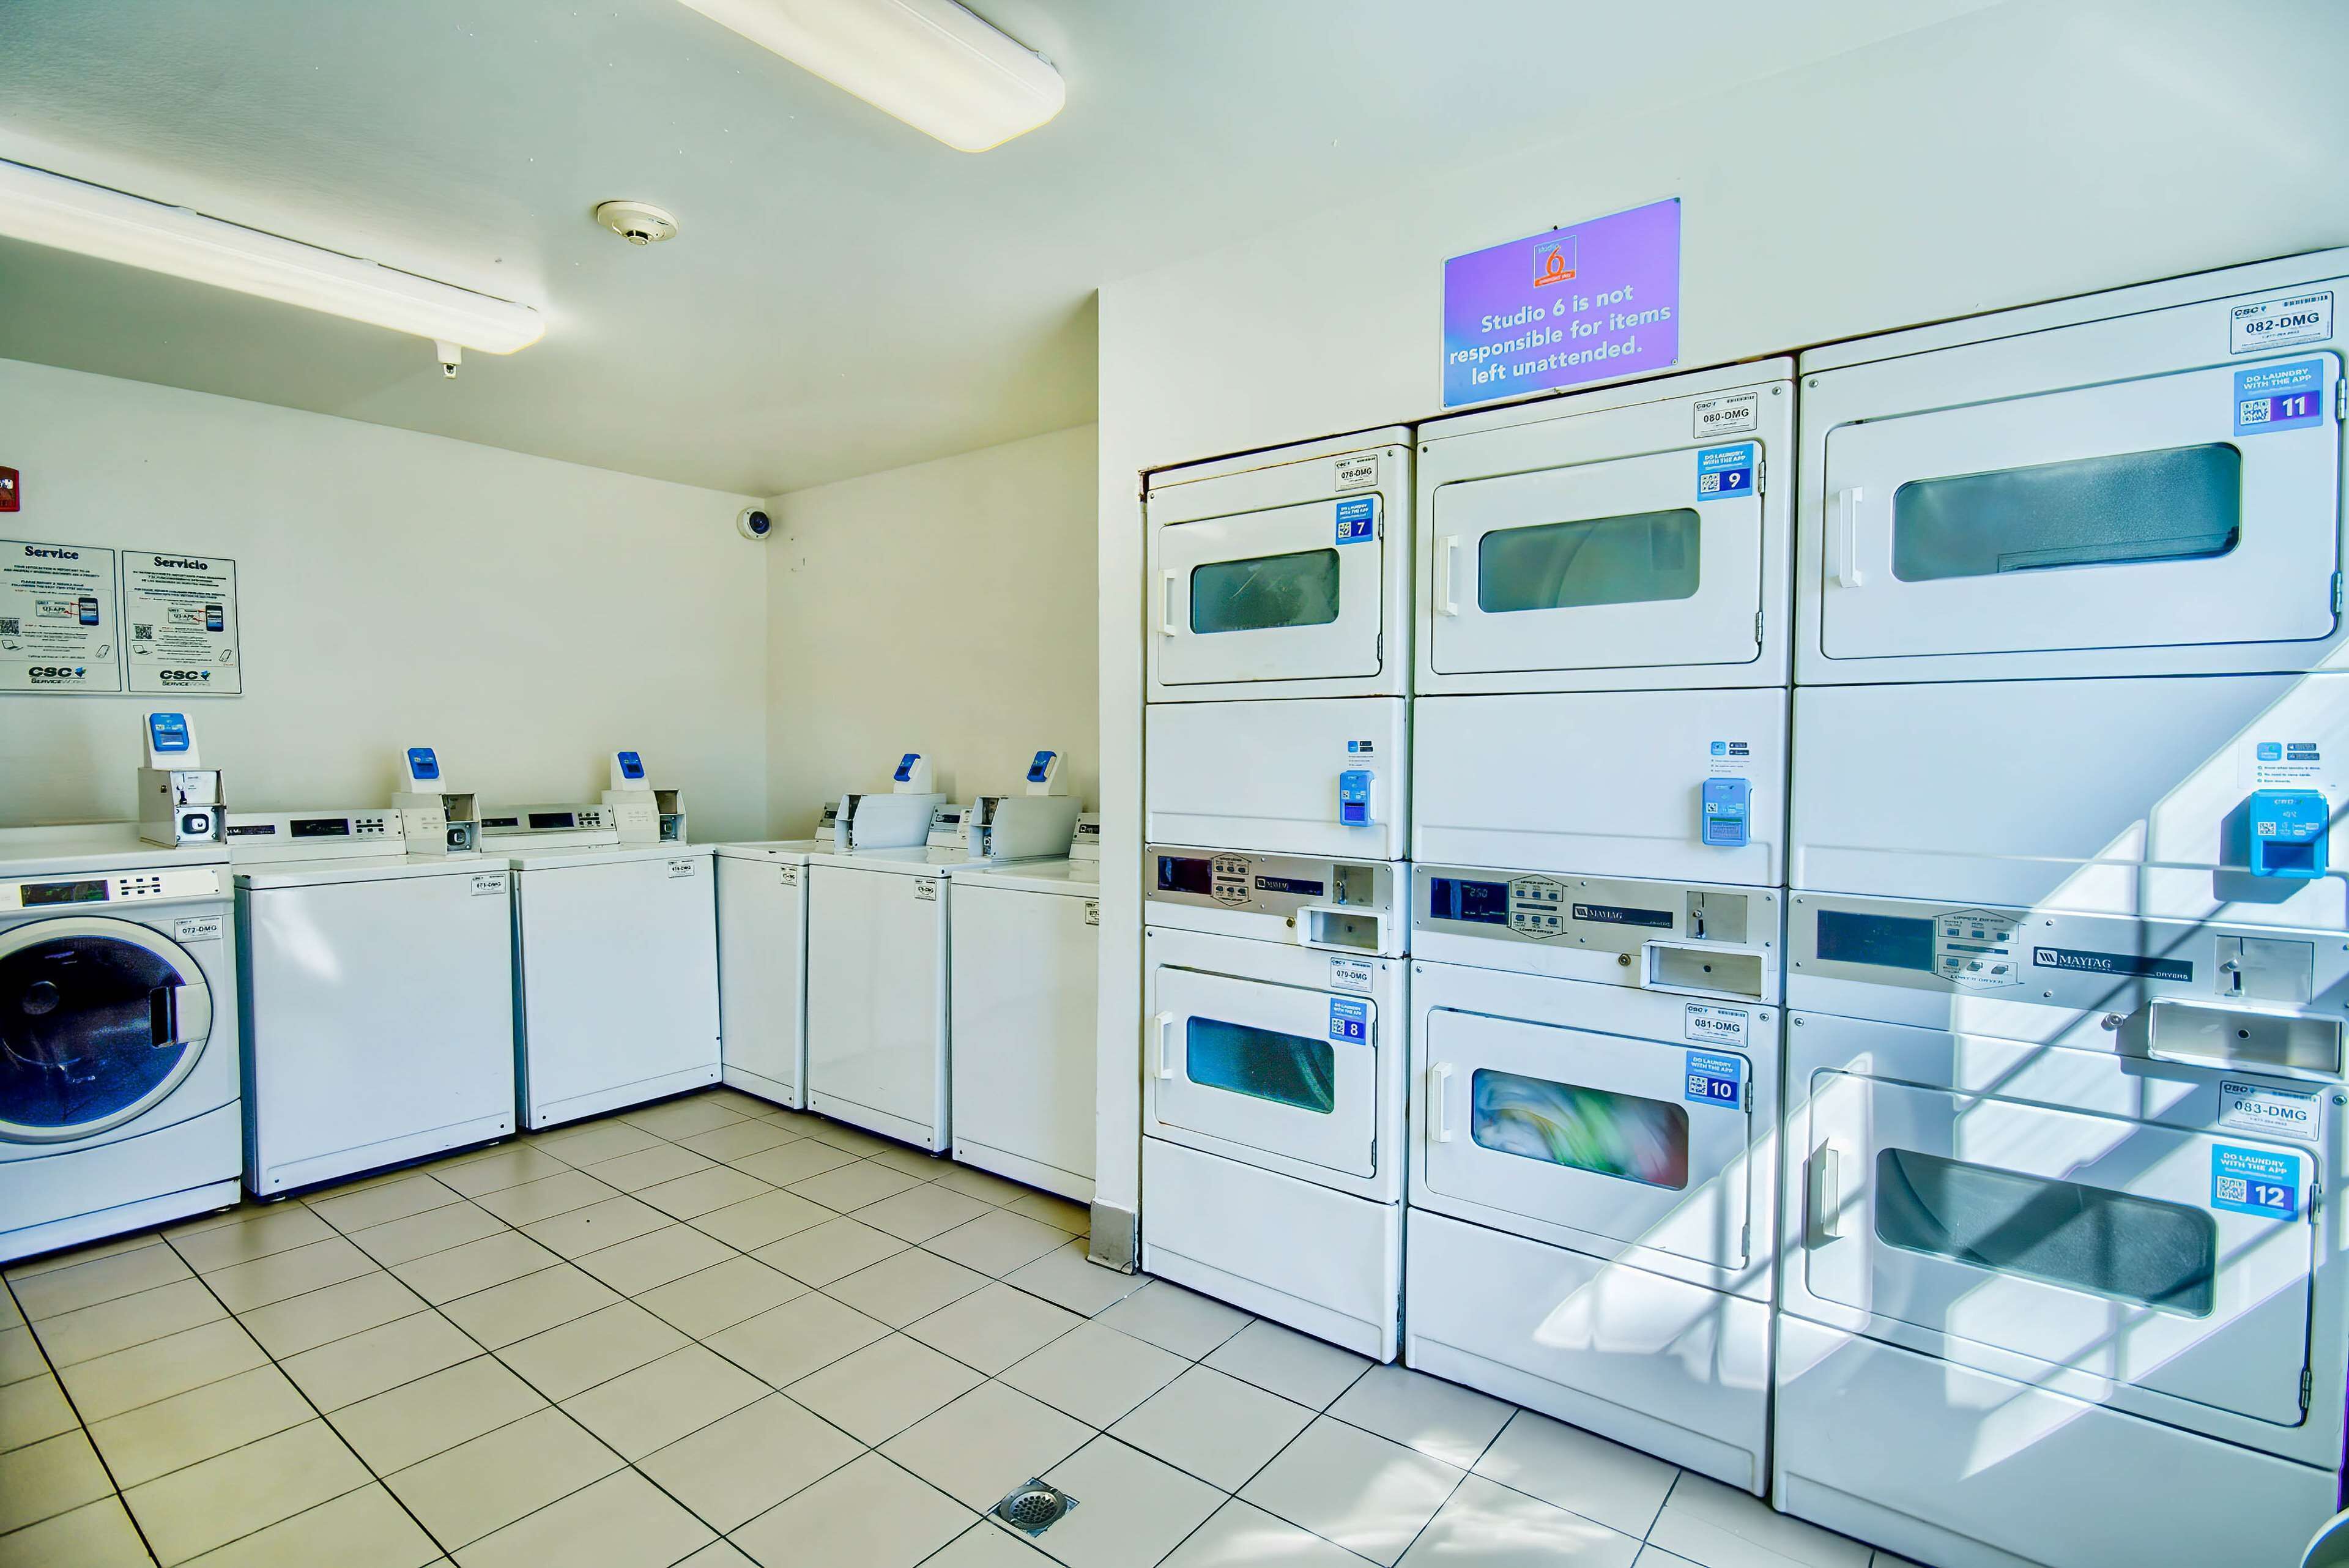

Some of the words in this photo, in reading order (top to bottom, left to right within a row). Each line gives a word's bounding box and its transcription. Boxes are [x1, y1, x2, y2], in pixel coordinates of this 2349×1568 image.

[1546, 245, 1565, 275] 6
[1482, 306, 1545, 333] Studio
[1553, 299, 1565, 317] 6
[1573, 295, 1589, 313] is
[1596, 284, 1634, 308] not
[2246, 312, 2320, 333] 082-DMG
[1450, 327, 1563, 365] responsible
[1570, 320, 1602, 339] for
[1609, 306, 1671, 332] items
[1472, 364, 1507, 385] left
[1513, 336, 1642, 377] unattended.
[2243, 381, 2269, 390] WITH
[2271, 377, 2290, 386] THE
[2291, 374, 2312, 384] APP
[2262, 368, 2309, 381] LAUNDRY
[2282, 396, 2306, 417] 11
[1704, 408, 1750, 423] 080-DMG
[1341, 467, 1373, 478] 078-DMG
[1729, 472, 1741, 488] 9
[1357, 521, 1365, 534] 7
[25, 546, 79, 560] Service
[154, 556, 208, 570] Servicio
[29, 666, 72, 677] CSC
[160, 670, 199, 680] CSC
[2059, 954, 2112, 969] MAYTAG
[1350, 1024, 1359, 1036] 8
[1695, 1018, 1740, 1033] 081-DMG
[1712, 1082, 1732, 1098] 10
[2235, 1101, 2307, 1121] 083-DMG
[2221, 1158, 2246, 1167] WITH
[2247, 1162, 2266, 1172] THE
[2268, 1165, 2287, 1174] APP
[2239, 1155, 2284, 1167] LAUNDRY
[2255, 1185, 2285, 1208] 12
